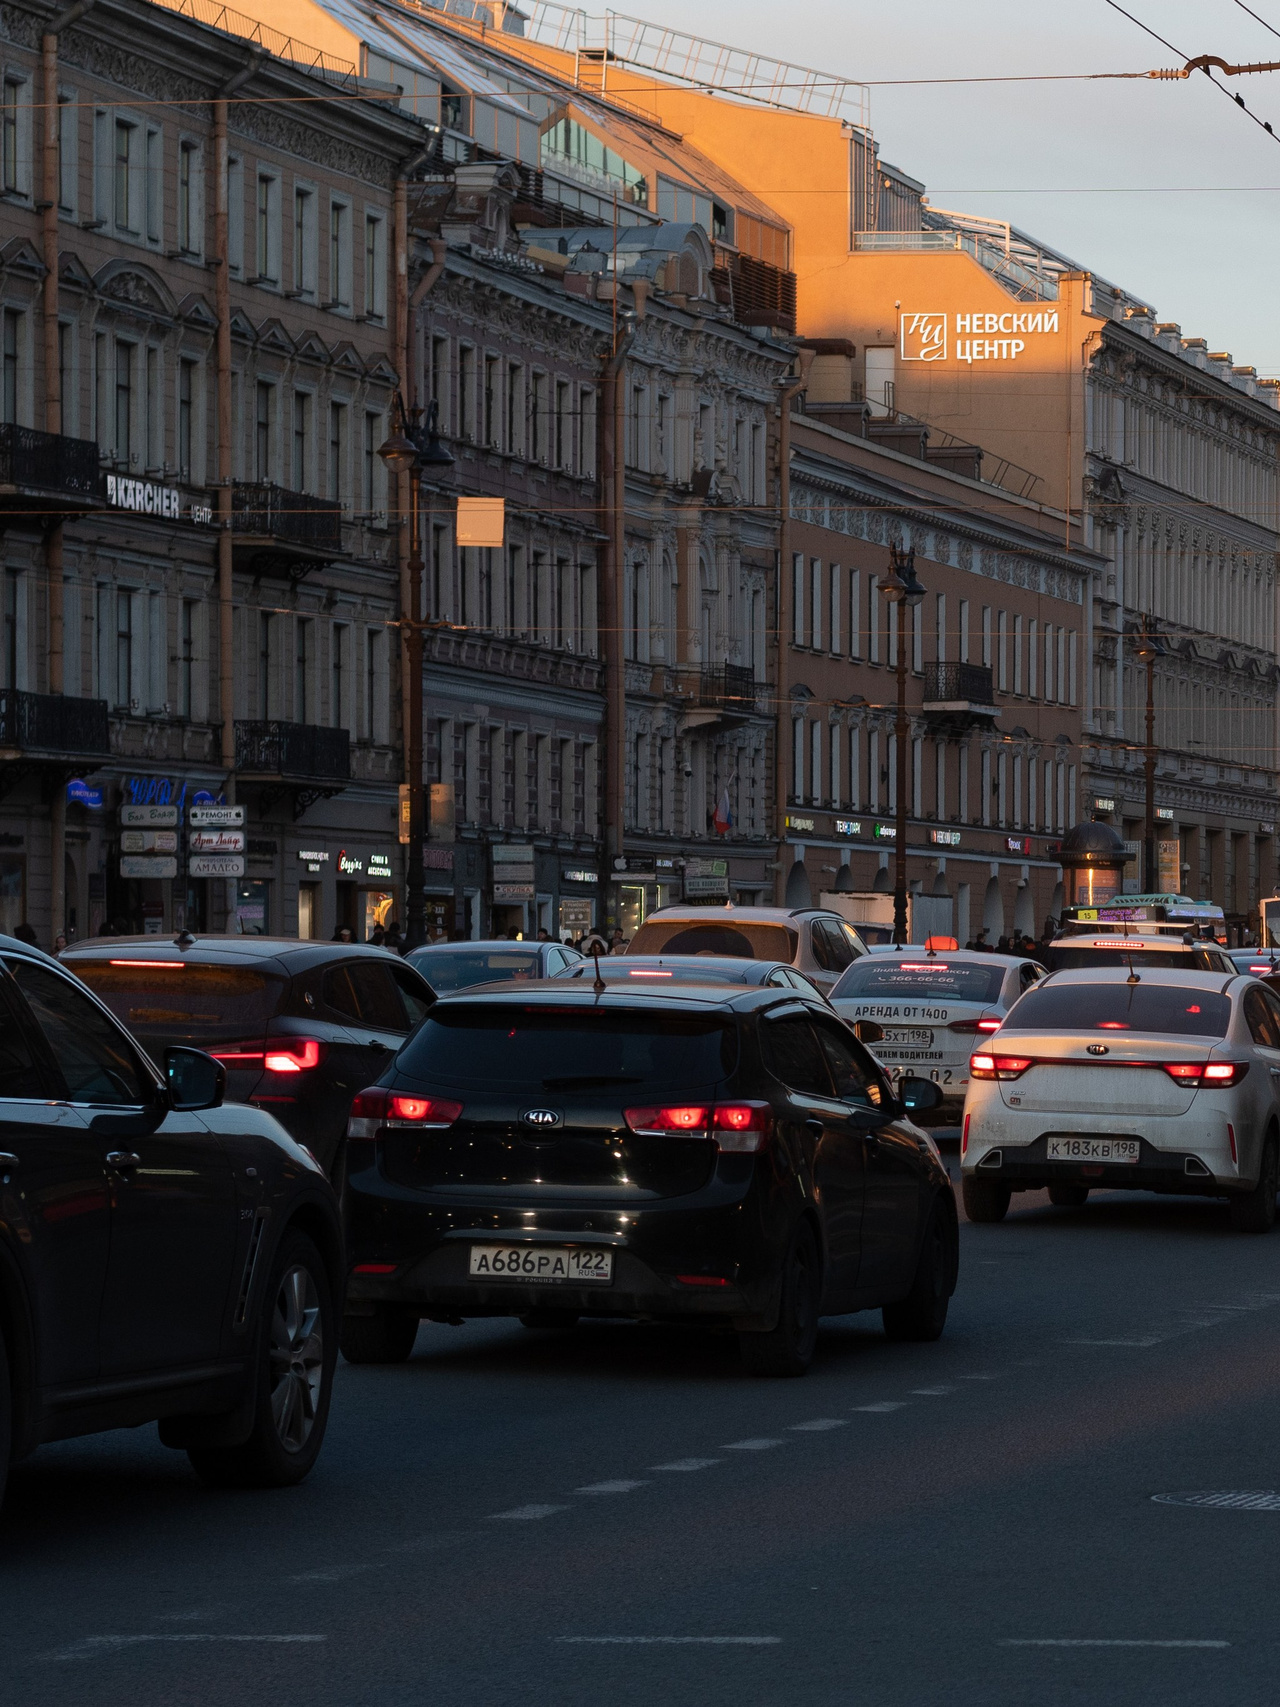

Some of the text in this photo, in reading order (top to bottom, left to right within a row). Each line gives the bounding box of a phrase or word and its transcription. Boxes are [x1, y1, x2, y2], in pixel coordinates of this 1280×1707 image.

[956, 309, 1058, 333] НЕВСКИЙ
[956, 339, 1024, 363] ЦЕНТР
[200, 811, 232, 819] РЕМОНТ
[855, 1007, 948, 1020] АРЕНДА ОТ 1400
[910, 1030, 927, 1039] 198
[899, 1051, 944, 1060] ВОДИТЕЛЕЙ
[529, 1112, 553, 1123] KIA
[1051, 1141, 1136, 1157] К183КВ 198
[476, 1250, 605, 1275] А686РА 122
[578, 1269, 596, 1277] RUS
